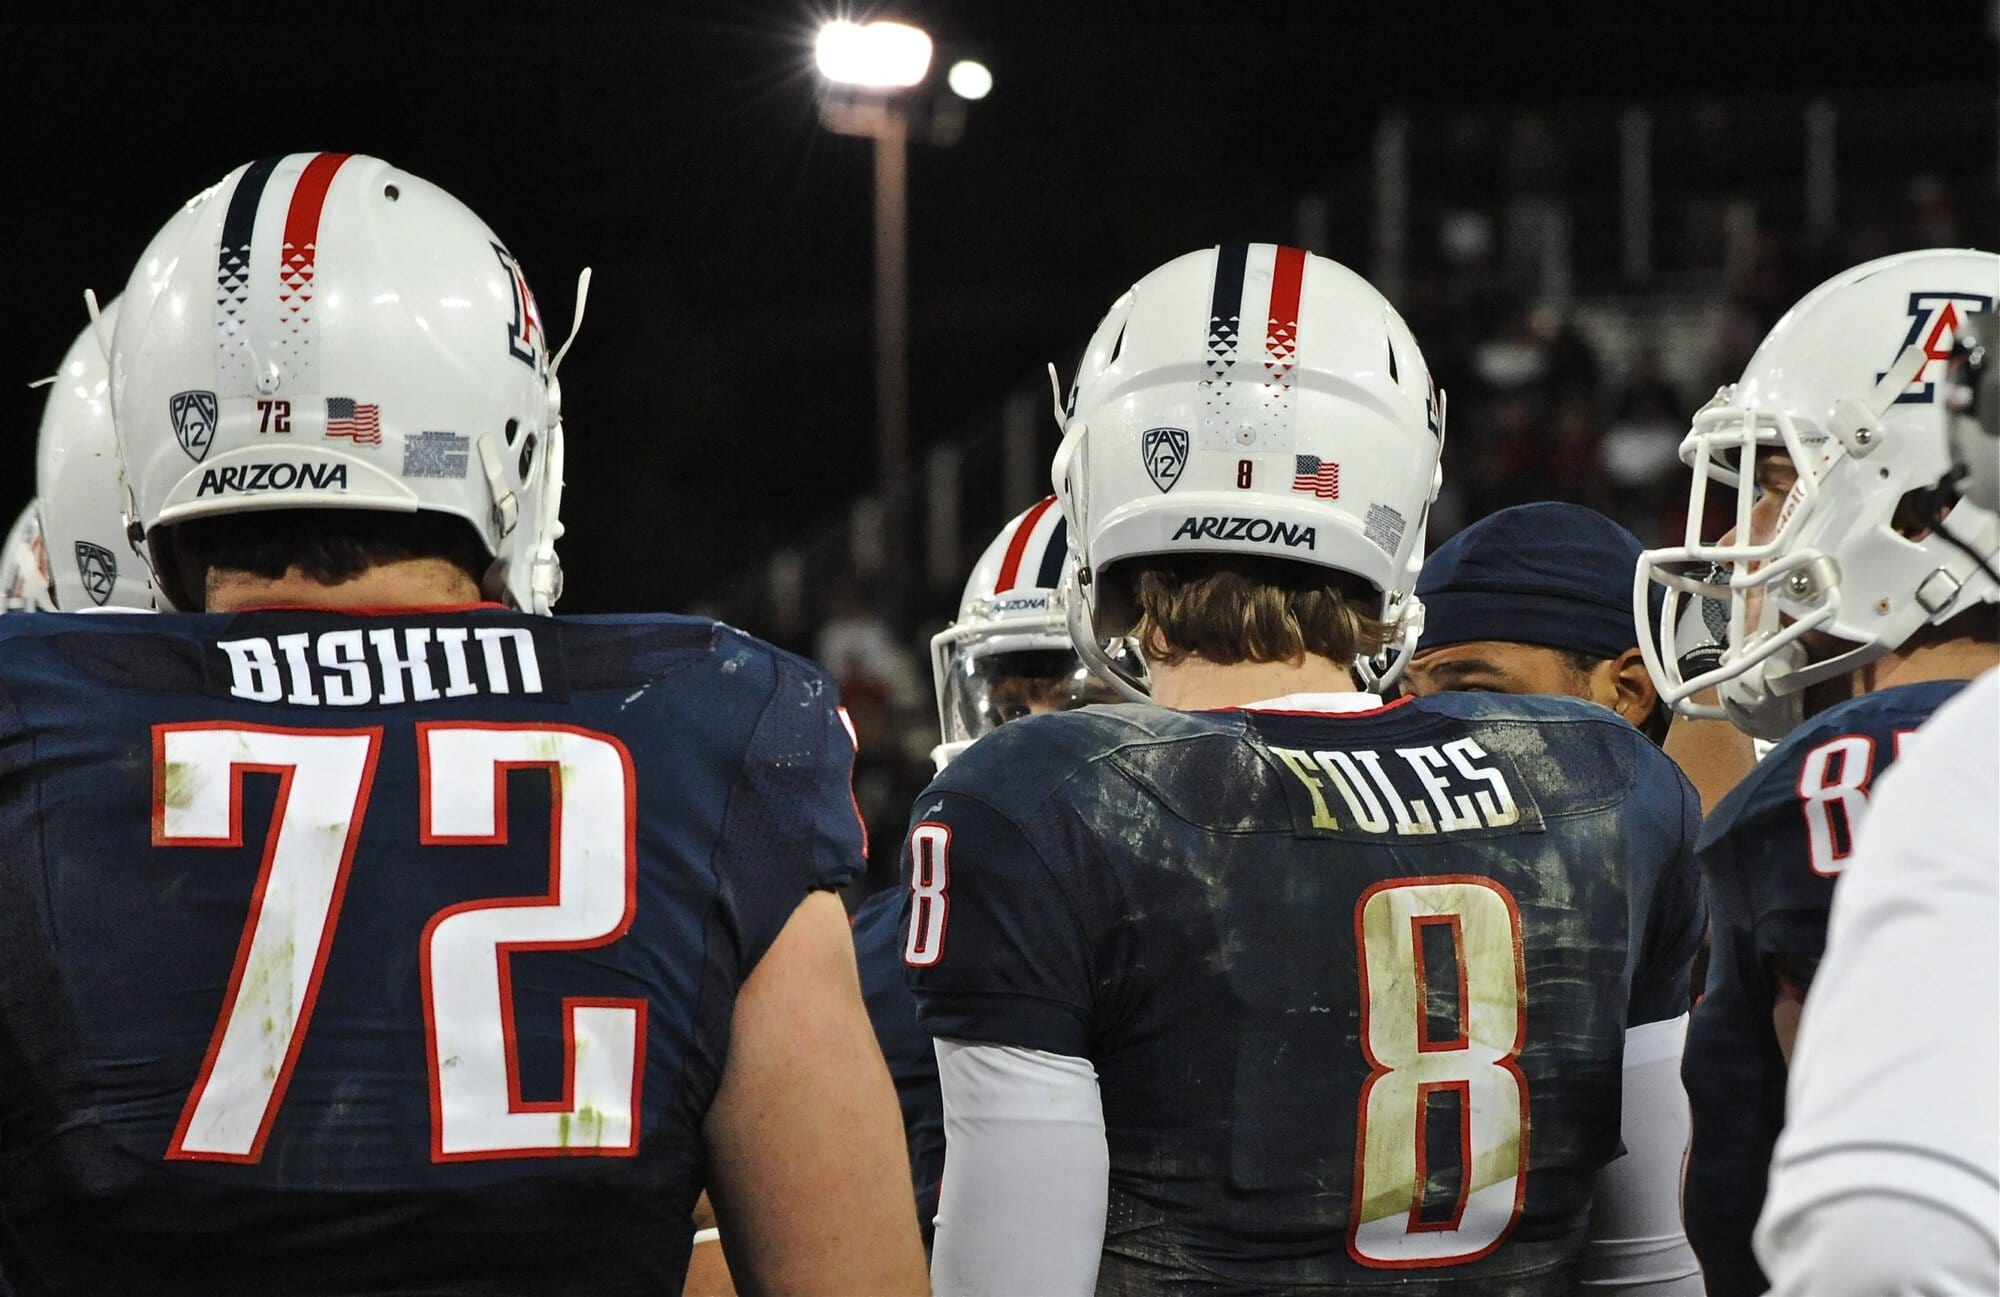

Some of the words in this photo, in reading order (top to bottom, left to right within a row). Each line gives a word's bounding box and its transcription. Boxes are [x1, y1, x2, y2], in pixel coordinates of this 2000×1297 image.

[172, 395, 214, 434] PAC
[256, 400, 290, 433] 72
[185, 422, 207, 448] 12
[1146, 431, 1185, 466] PAC
[197, 463, 347, 497] ARIZONA
[1154, 456, 1175, 478] 12
[1237, 459, 1253, 489] 8
[1172, 517, 1316, 550] ARIZONA
[78, 545, 115, 586] PAC
[992, 599, 1045, 612] AIZONA
[1268, 737, 1520, 835] FOLES
[903, 821, 952, 967] 8
[152, 721, 647, 1165] 72
[1346, 874, 1531, 1271] 8
